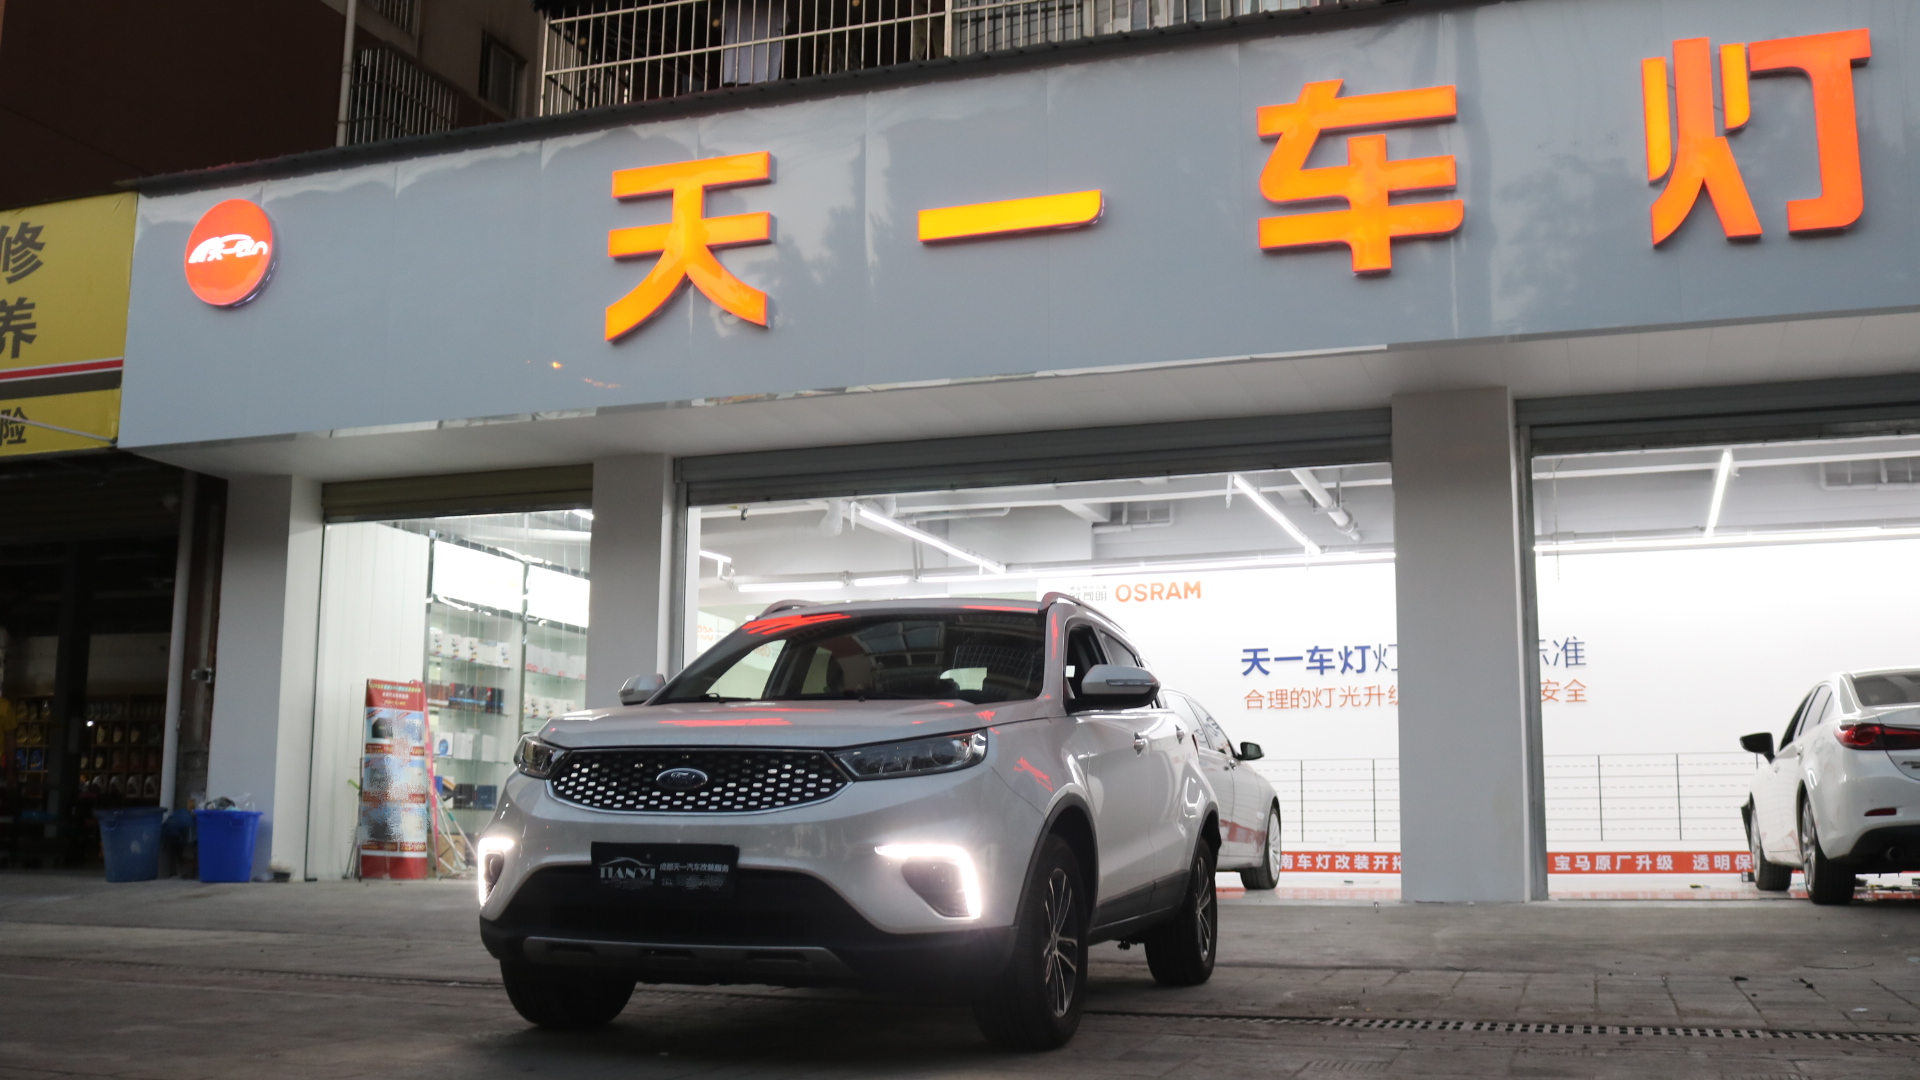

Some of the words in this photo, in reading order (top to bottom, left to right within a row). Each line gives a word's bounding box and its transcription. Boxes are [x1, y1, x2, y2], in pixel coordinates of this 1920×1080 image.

[605, 28, 1871, 343] 天一车灯
[0, 221, 46, 285] 修
[1115, 581, 1202, 602] OSRAM
[1540, 679, 1587, 702] 安全
[1554, 854, 1673, 871] 宝马原厂升级
